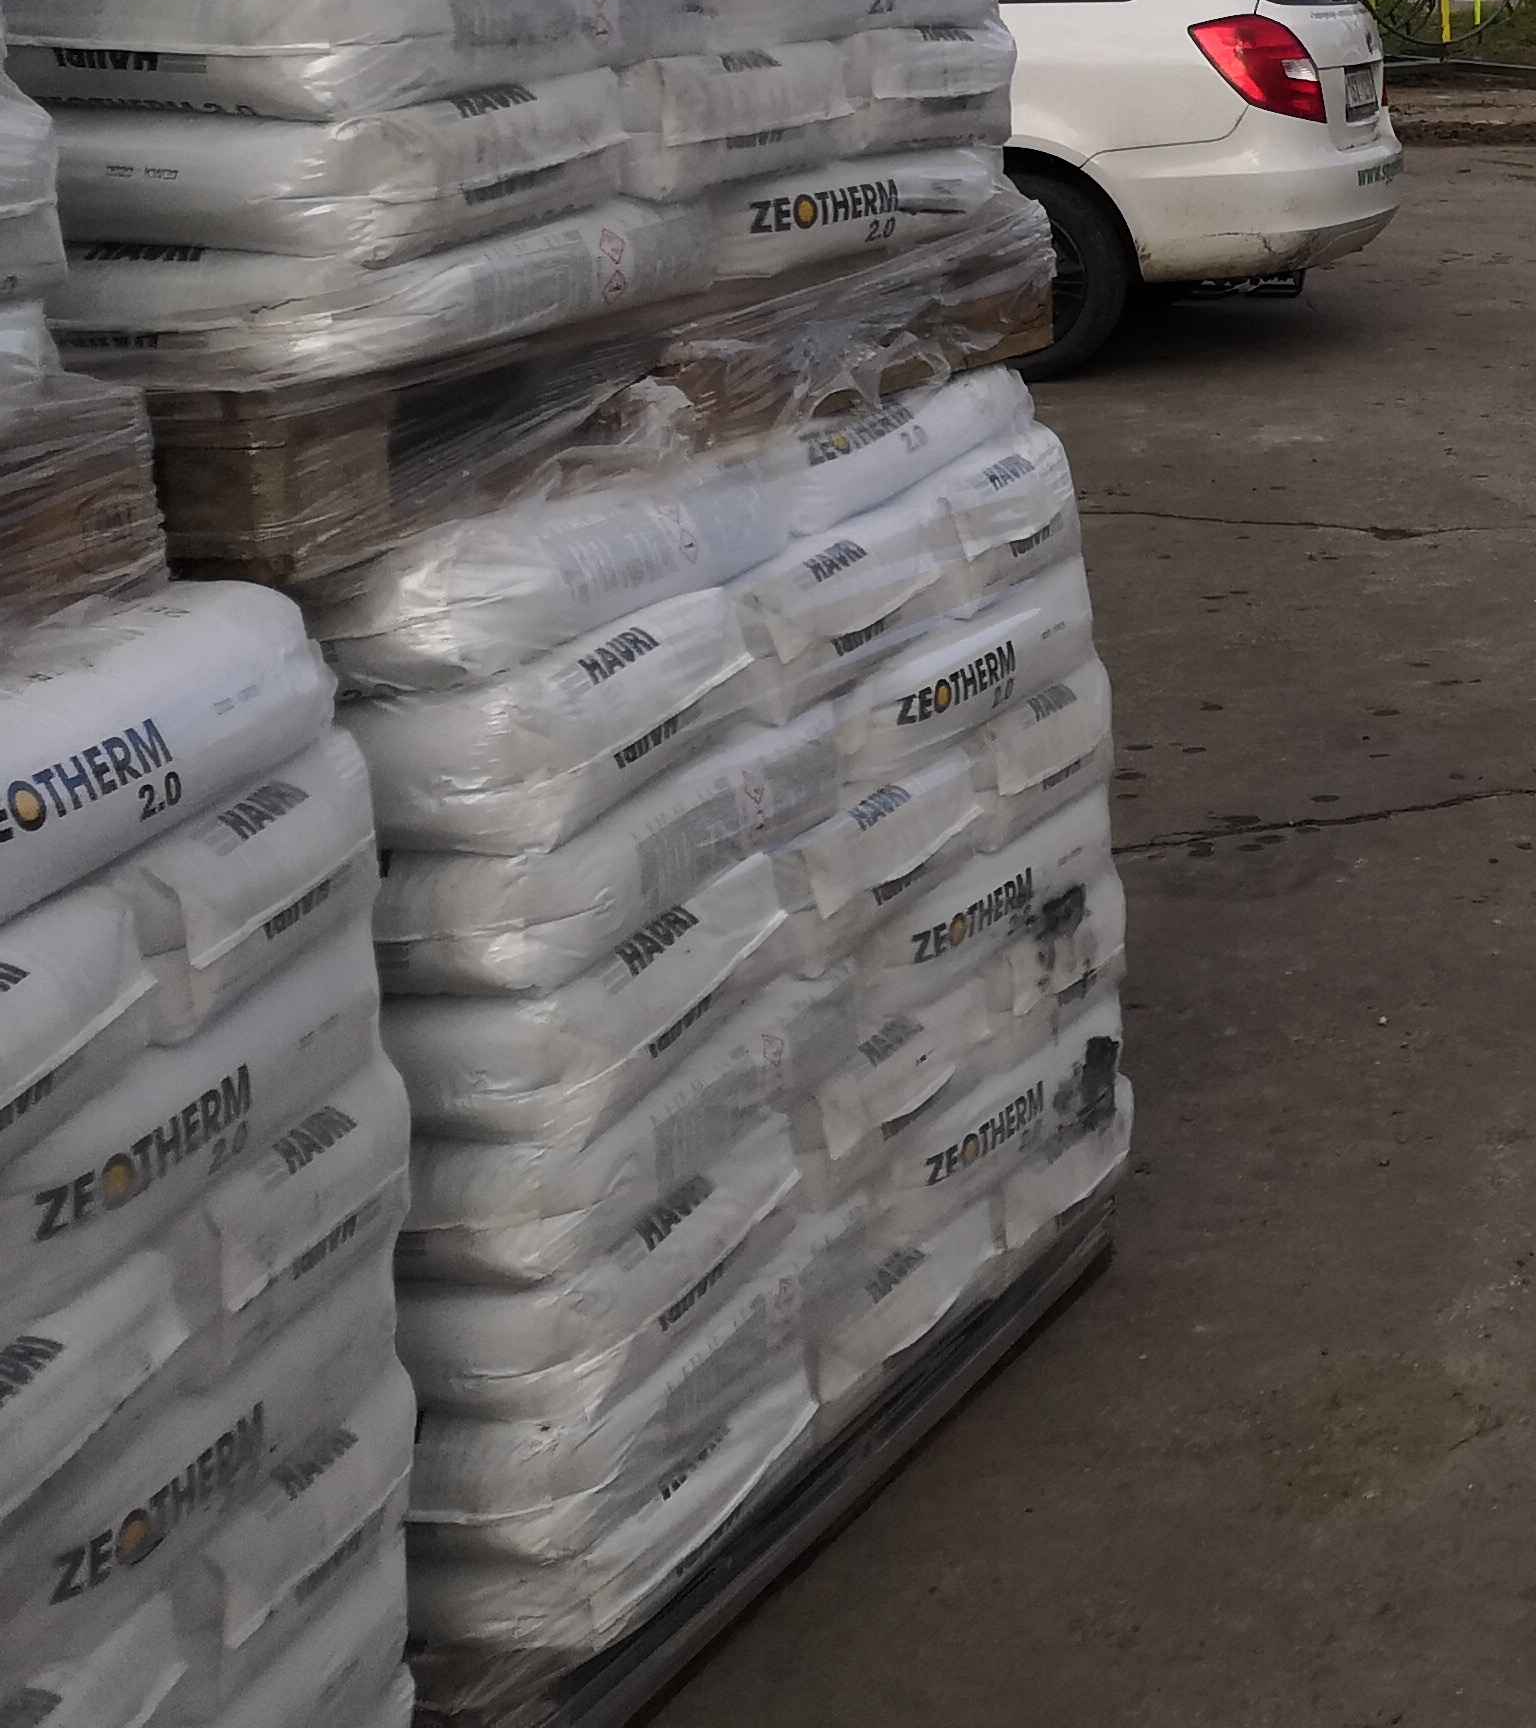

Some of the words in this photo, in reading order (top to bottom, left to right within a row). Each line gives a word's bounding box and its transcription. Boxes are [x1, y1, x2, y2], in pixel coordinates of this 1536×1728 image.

[750, 179, 899, 234] ZEOTHERM
[865, 221, 895, 251] 2.0
[896, 641, 1017, 726] ZEOTHERM
[138, 772, 182, 822] 2.0
[912, 868, 1034, 964] ZEOTHERM
[33, 1063, 252, 1242] ZEOTHERM
[925, 1081, 1045, 1186] ZEOTHERM
